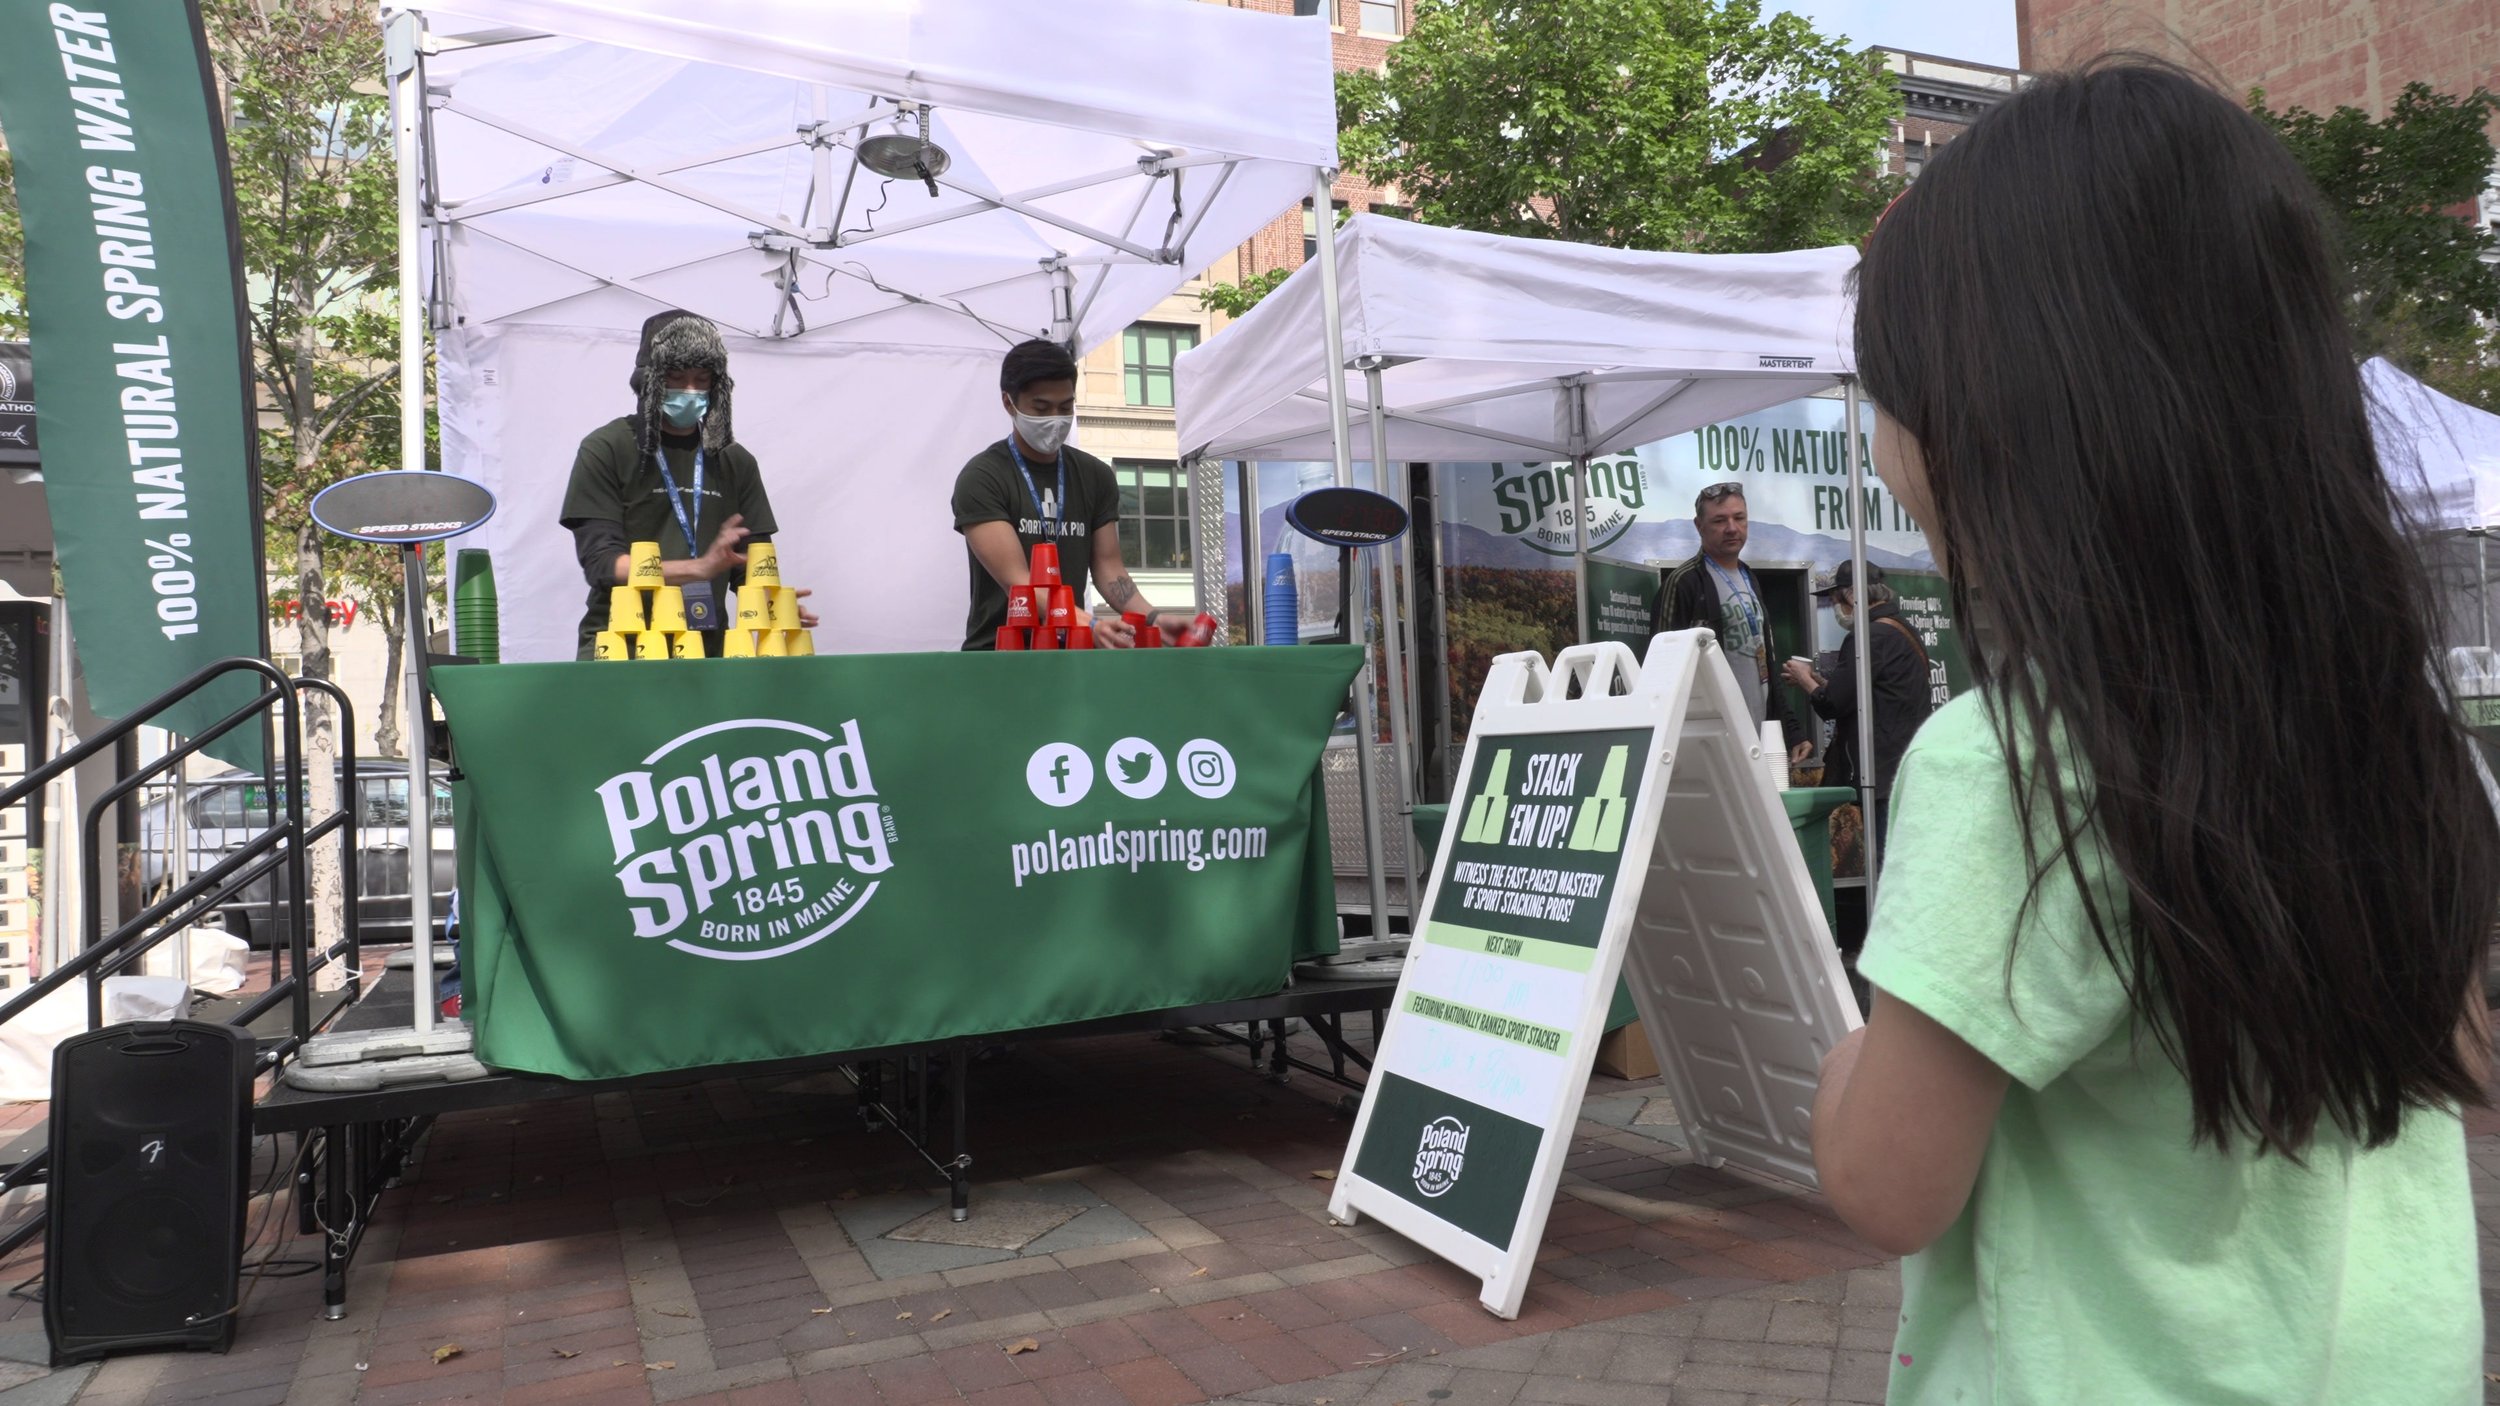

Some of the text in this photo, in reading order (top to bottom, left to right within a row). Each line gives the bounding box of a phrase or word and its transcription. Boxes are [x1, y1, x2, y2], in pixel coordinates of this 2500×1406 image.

[50, 3, 199, 641] 100% NATURAL SPRING WATER
[1759, 359, 1813, 368] MASTERTENT
[1694, 424, 1764, 472] 100%
[1773, 428, 1878, 477] NATUA
[1493, 461, 1645, 534] Sprng
[359, 521, 463, 533] SPEED STACKS
[1321, 529, 1387, 540] SPEED STACKS
[1537, 509, 1624, 544] BORN MAINE
[1556, 506, 1596, 527] 185
[1933, 615, 1950, 629] Water
[594, 718, 879, 866] Poland
[1521, 753, 1584, 797] STACK
[882, 815, 899, 844] BRAND
[1538, 806, 1573, 849] UP!
[615, 802, 894, 938] Spring
[1012, 819, 1267, 887] polandspring.com
[732, 877, 805, 916] 1845
[1454, 861, 1605, 898] WITNESS THE FAST-PACED MASTERY
[699, 877, 856, 942] BORN IN MAINE
[1463, 887, 1575, 923] OF SPORT STACKING PROS!
[1484, 935, 1524, 957] NEXT SHOW
[1412, 996, 1561, 1052] FEATURING NATIONALLY RANKED SPORT STACKER
[1418, 1124, 1470, 1154] Poland
[1412, 1148, 1464, 1180] Spring
[1428, 1171, 1442, 1182] 1845
